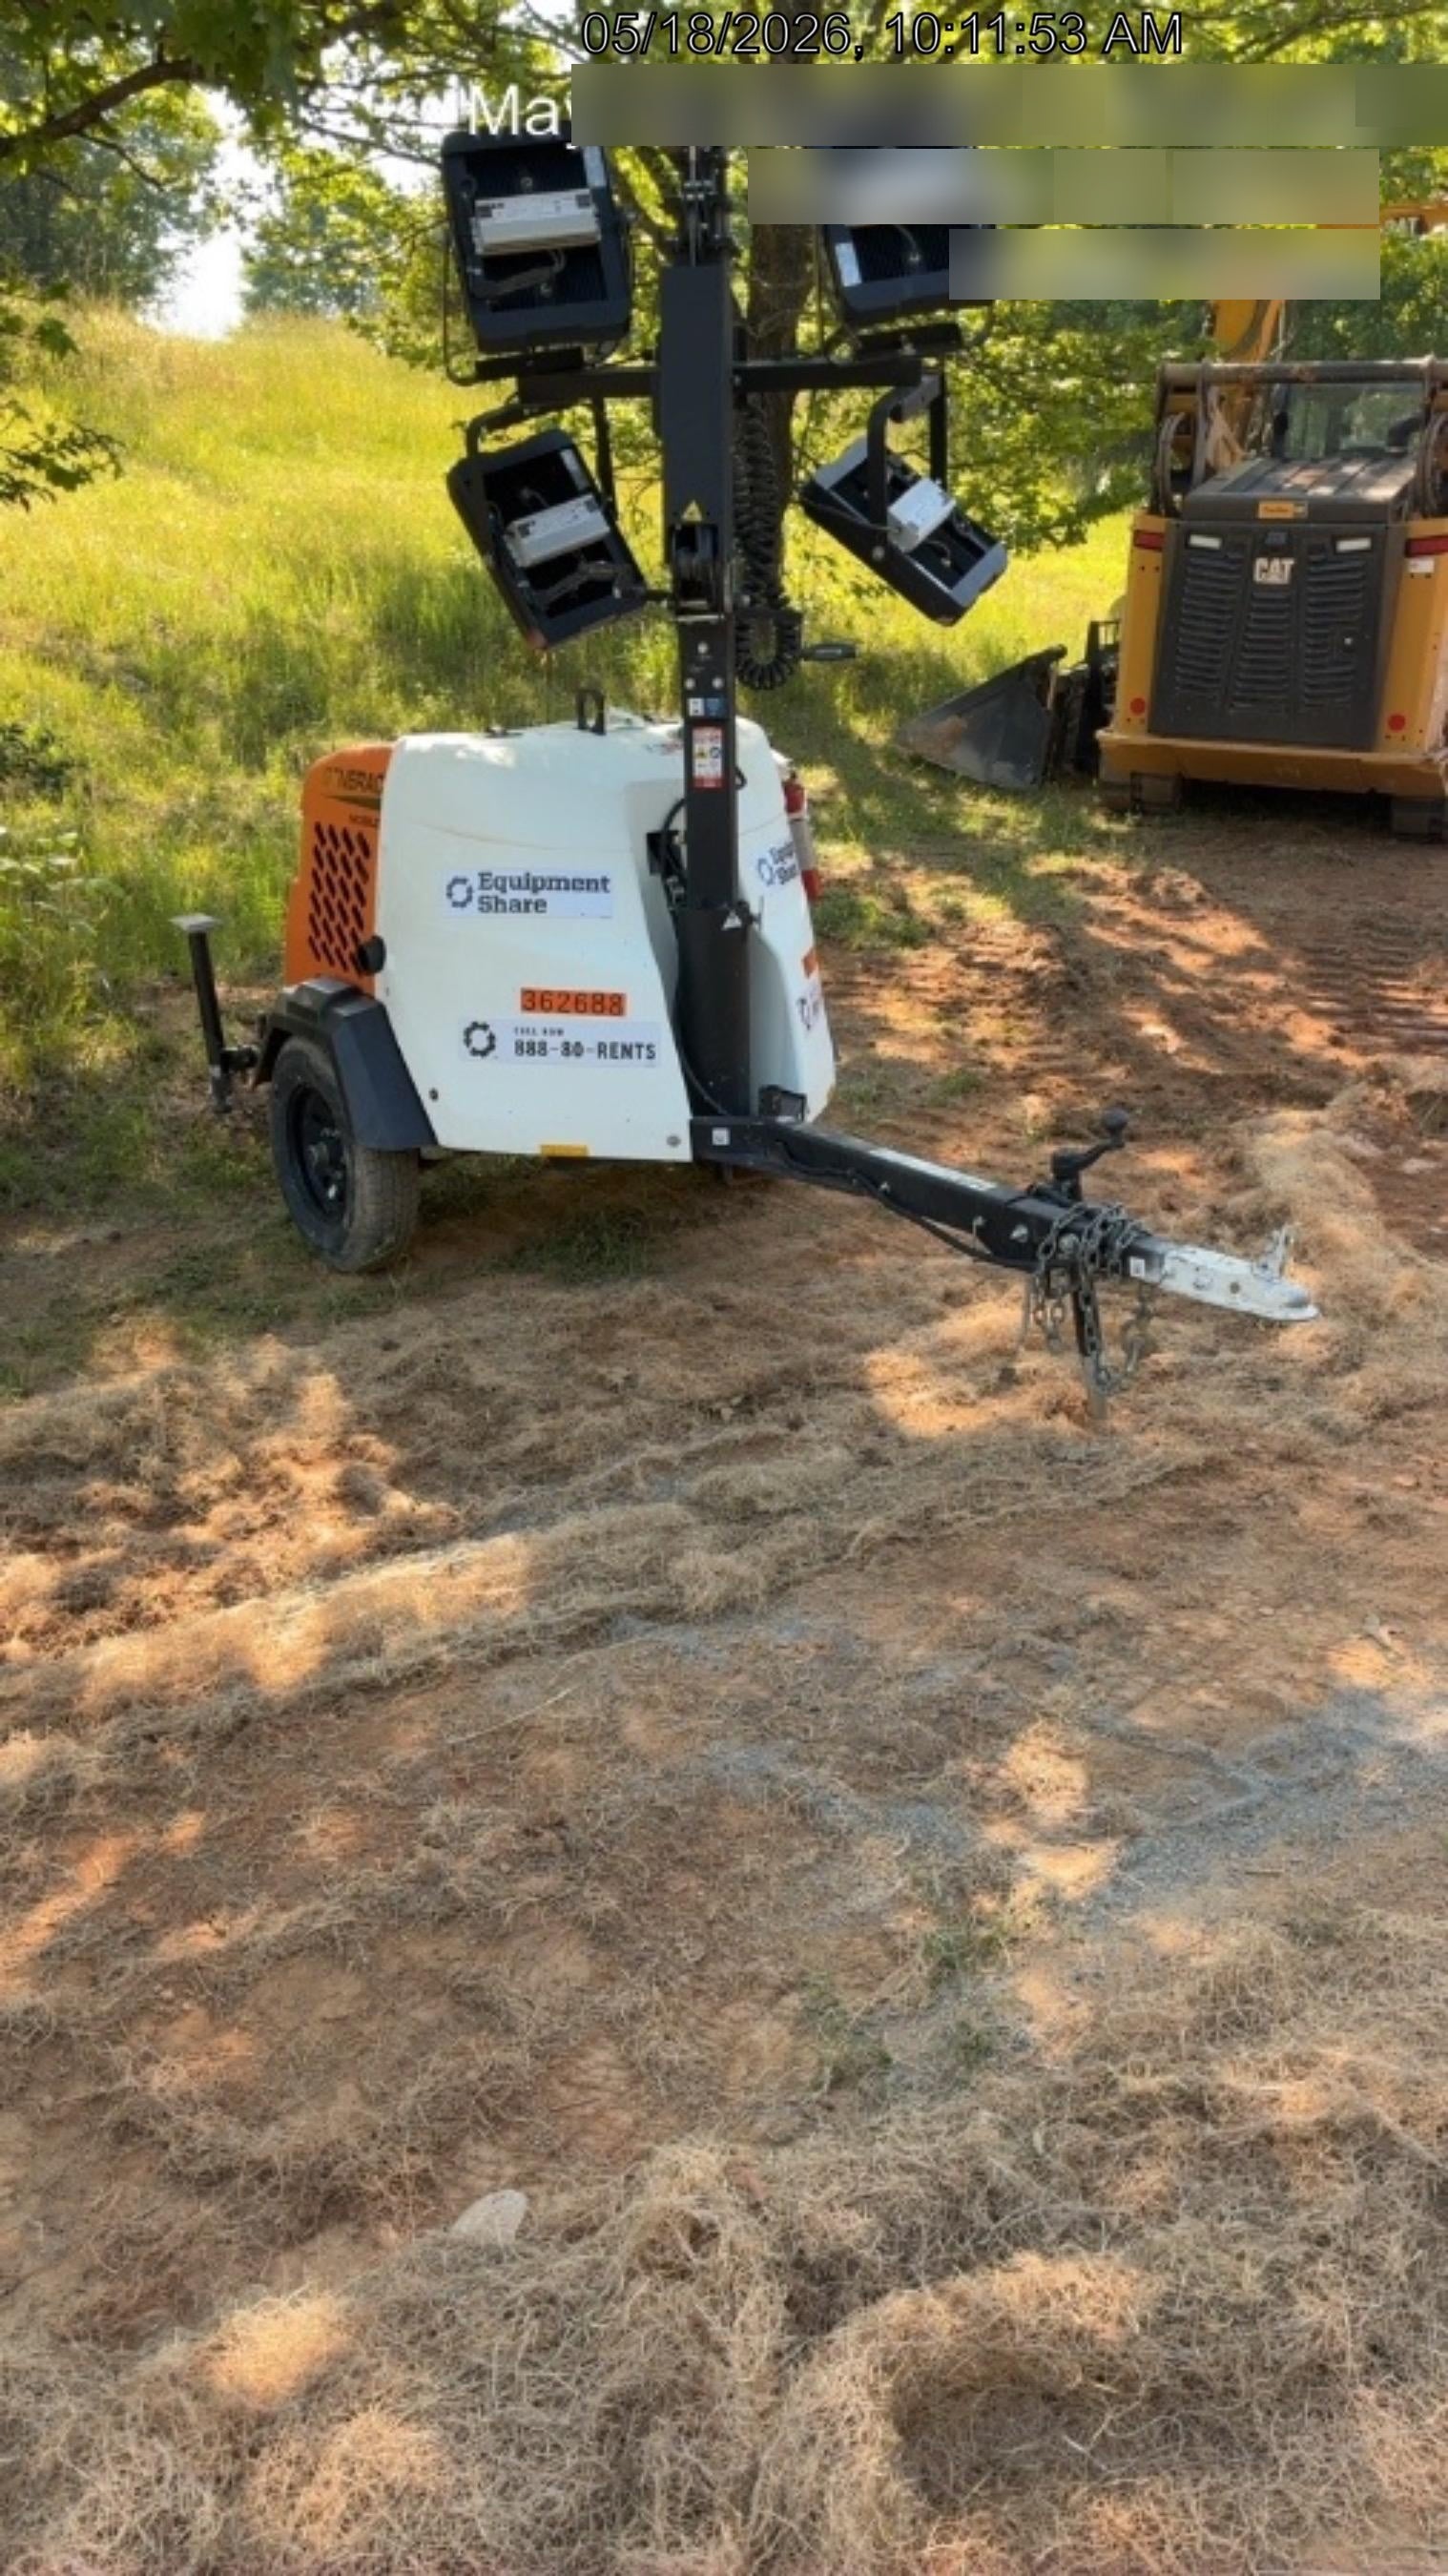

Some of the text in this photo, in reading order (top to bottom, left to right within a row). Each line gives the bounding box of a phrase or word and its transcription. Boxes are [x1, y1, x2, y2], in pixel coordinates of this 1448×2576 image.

[1253, 556, 1294, 584] CAT
[477, 871, 611, 895] Equipment
[477, 895, 548, 914] Share
[523, 989, 626, 1016] 362688
